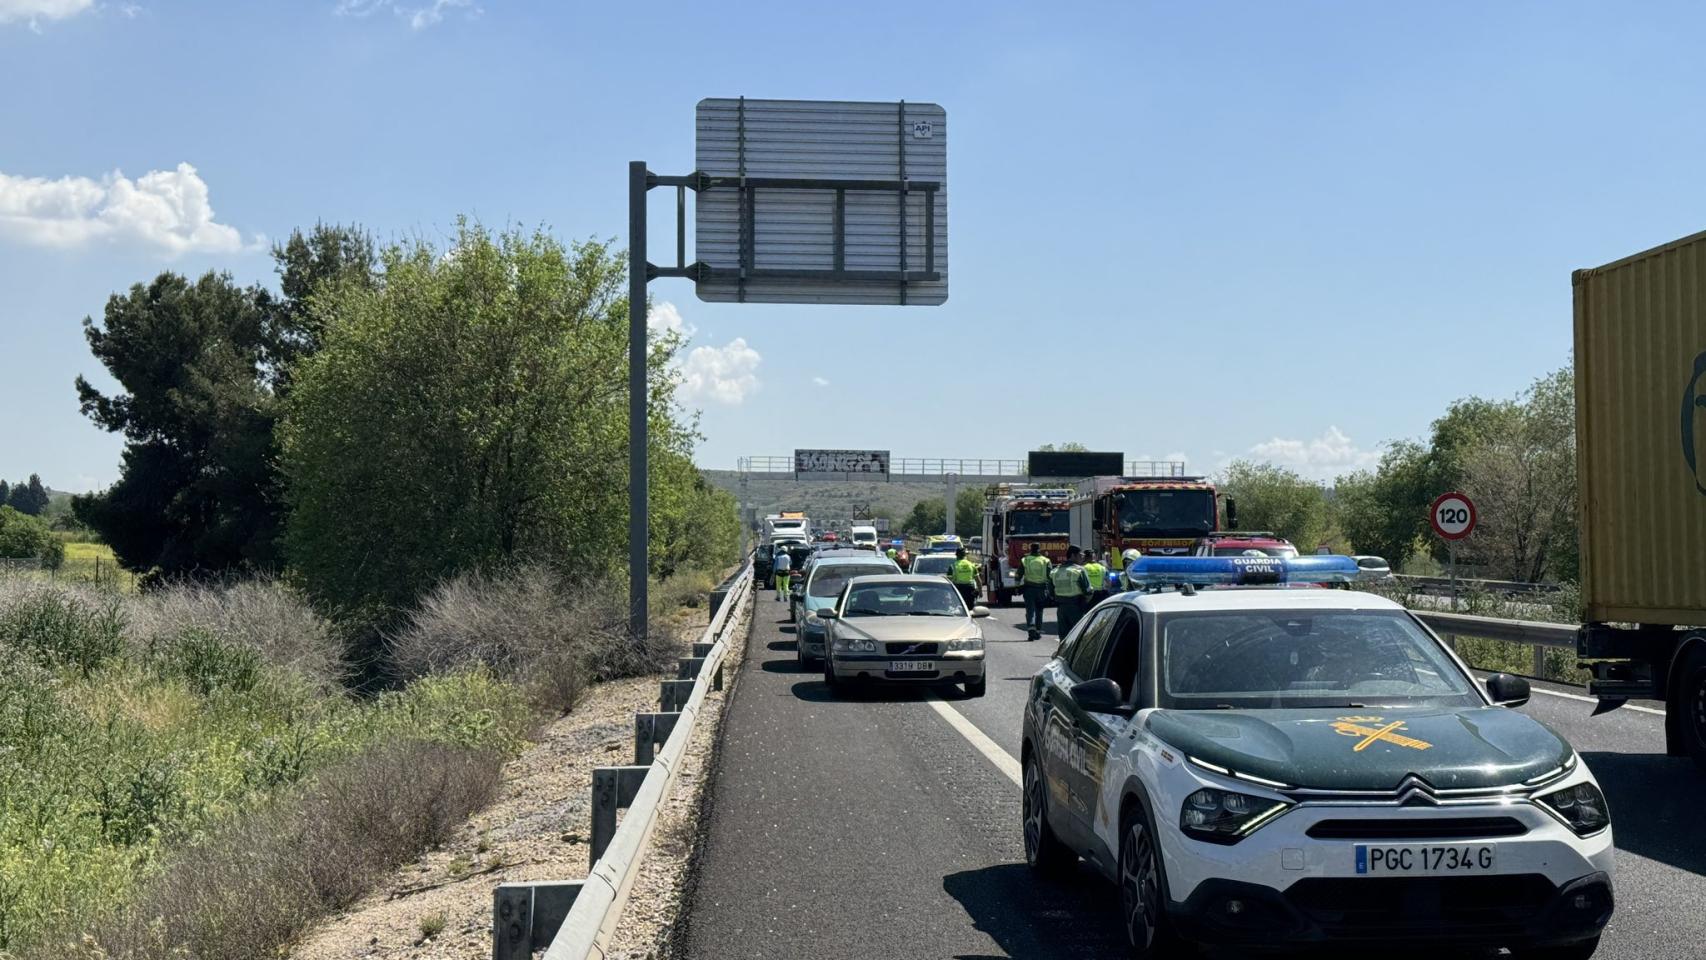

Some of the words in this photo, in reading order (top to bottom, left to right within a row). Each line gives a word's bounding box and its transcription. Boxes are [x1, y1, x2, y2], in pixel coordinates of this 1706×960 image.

[1439, 508, 1468, 524] 120
[1245, 565, 1274, 573] CIVIL
[1371, 848, 1412, 870] PGC
[1420, 847, 1473, 870] 1734
[1478, 847, 1492, 869] G
